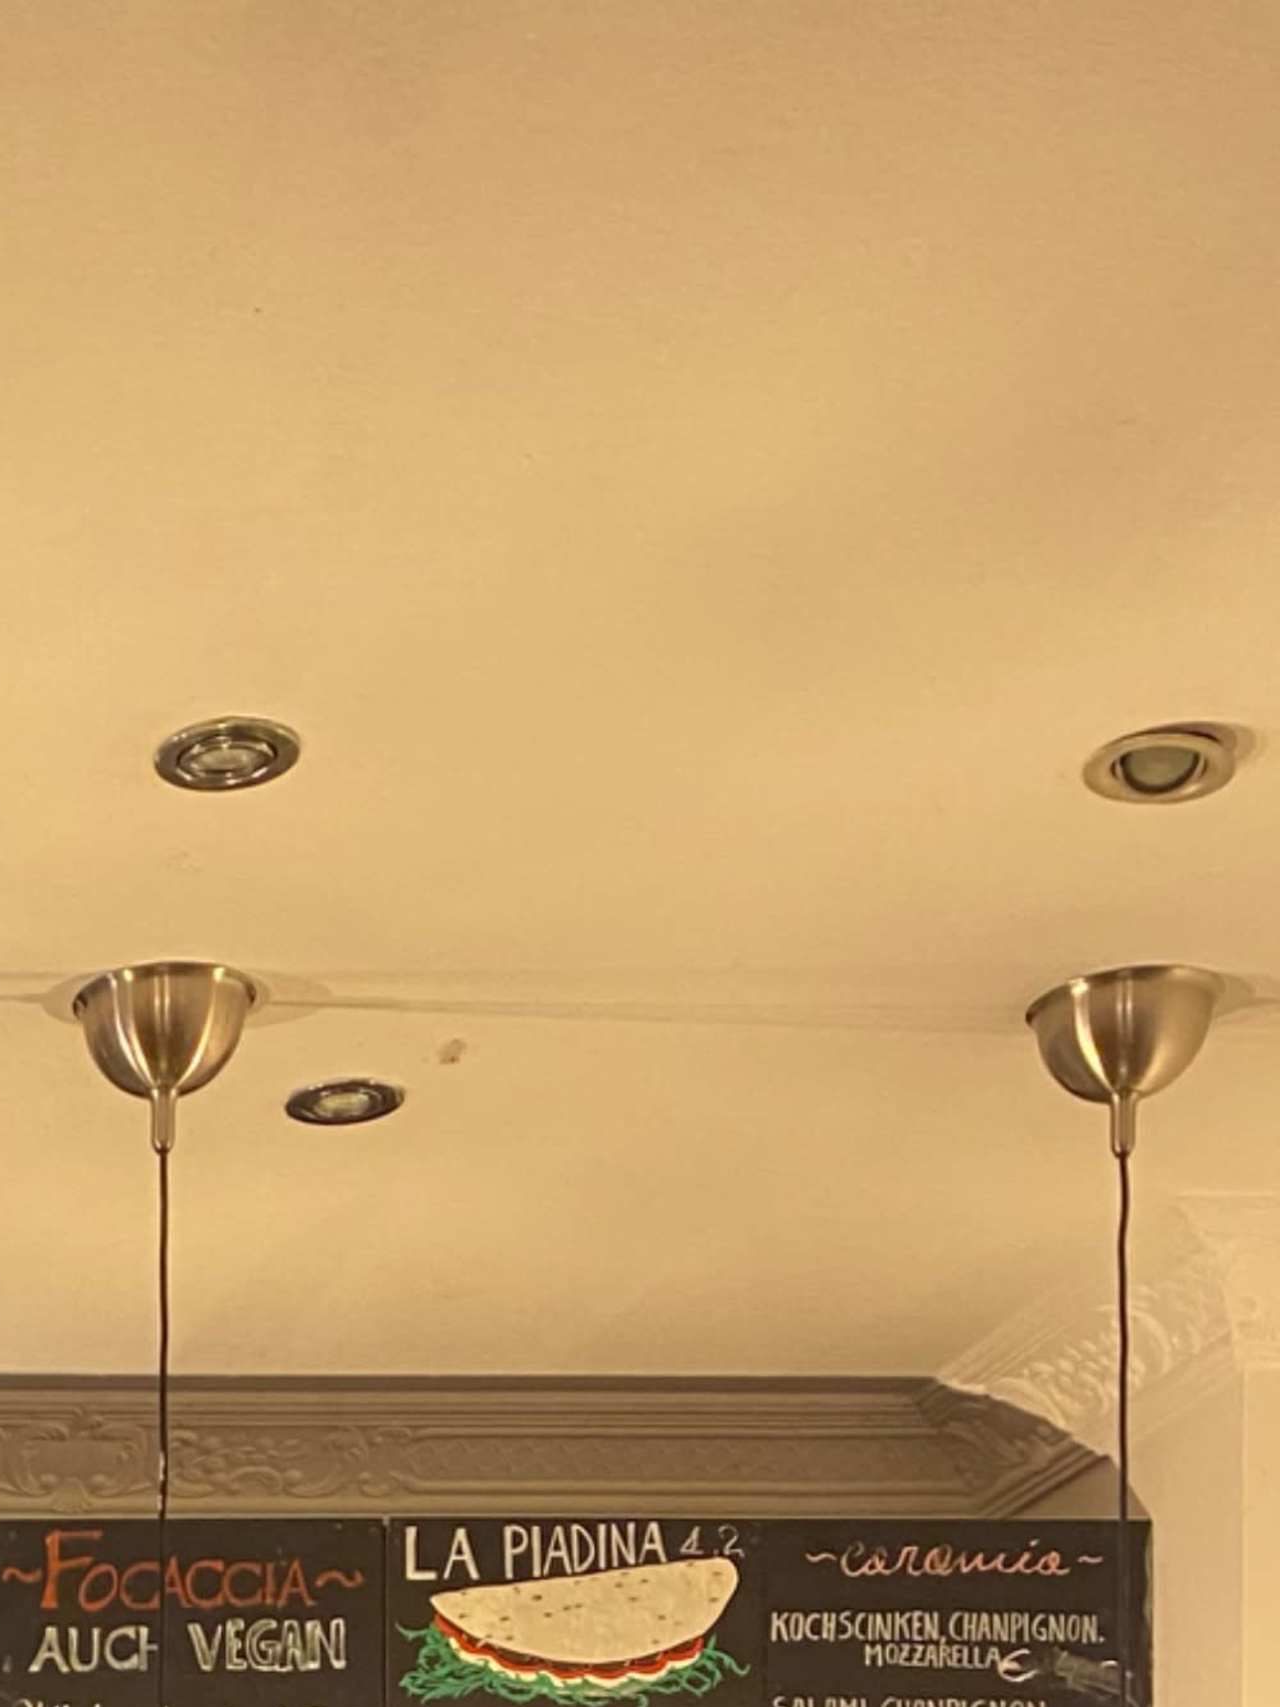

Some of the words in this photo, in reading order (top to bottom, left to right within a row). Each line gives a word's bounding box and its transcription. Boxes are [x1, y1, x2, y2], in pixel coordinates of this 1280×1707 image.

[405, 1525, 480, 1581] LA
[504, 1522, 667, 1579] PIADINA
[28, 1625, 159, 1674] AUCH
[187, 1617, 347, 1673] VEGAN
[865, 1645, 1000, 1669] MOZZARELLA
